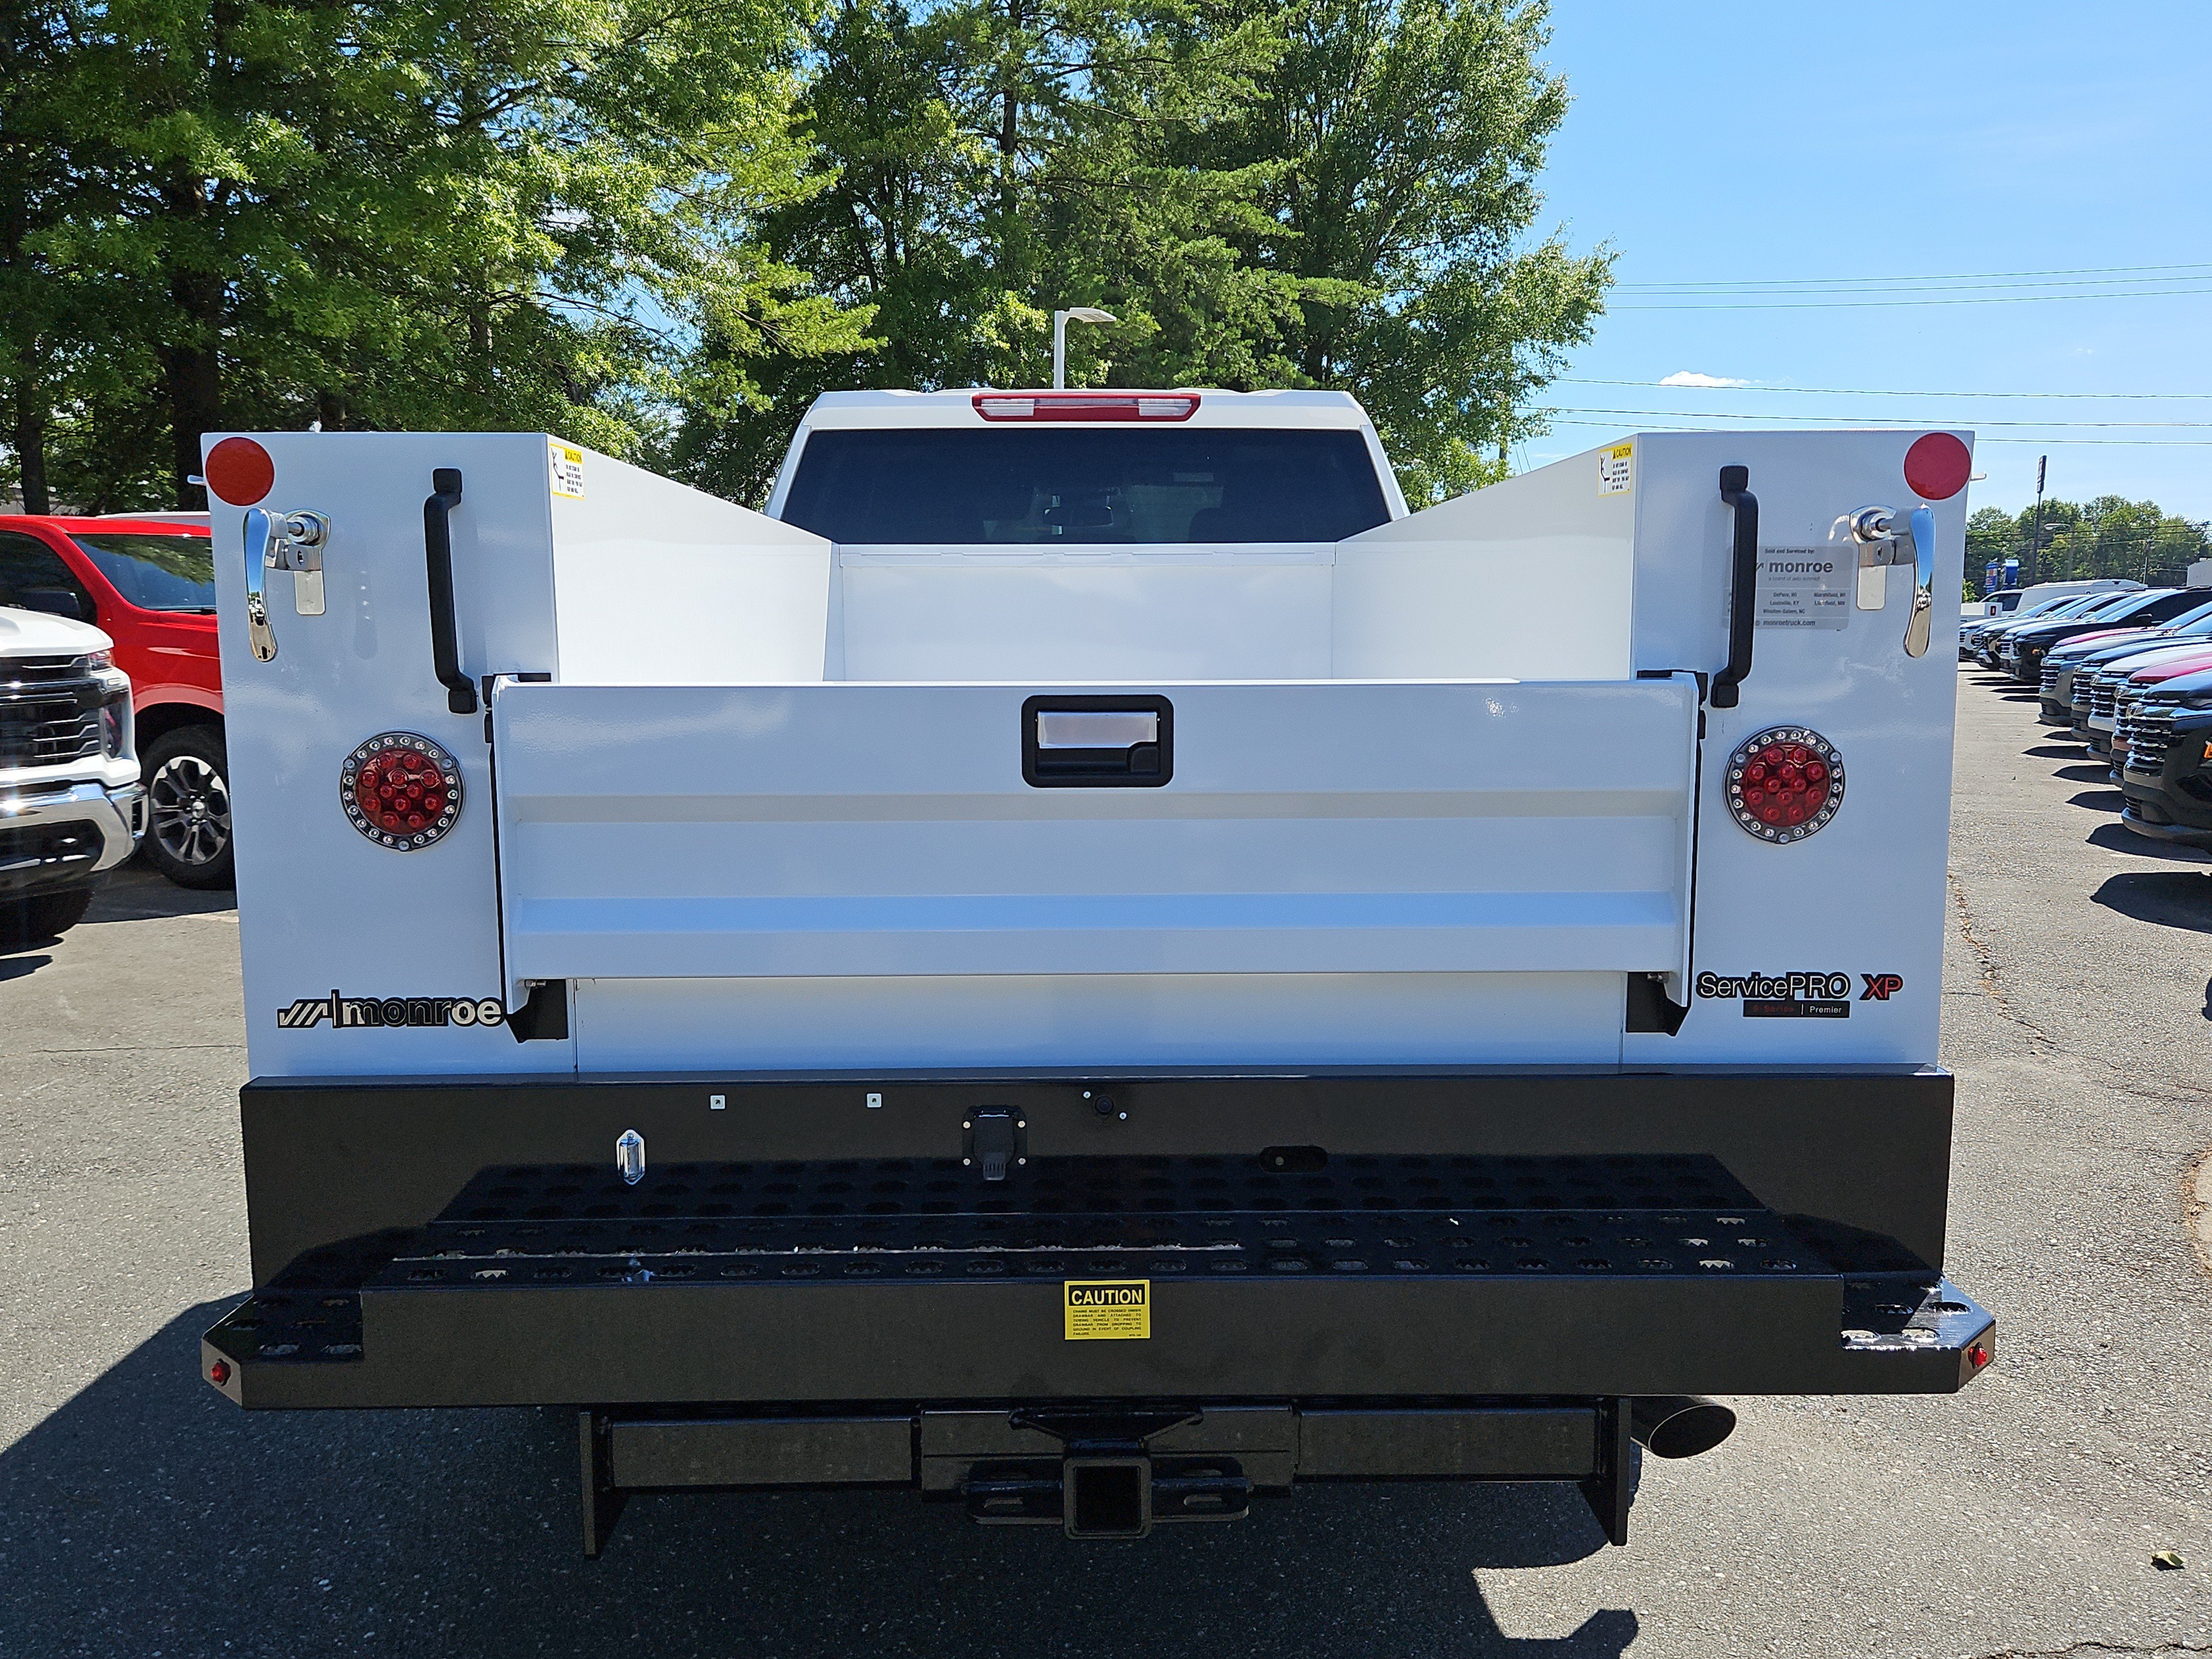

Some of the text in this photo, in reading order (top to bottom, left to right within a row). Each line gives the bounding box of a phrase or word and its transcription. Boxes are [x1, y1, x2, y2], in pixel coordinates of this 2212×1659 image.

[1769, 562, 1833, 573] monroe
[1698, 973, 1903, 999] ServicePRO XP
[342, 998, 503, 1026] monroe
[1071, 1289, 1142, 1304] CAUTION
